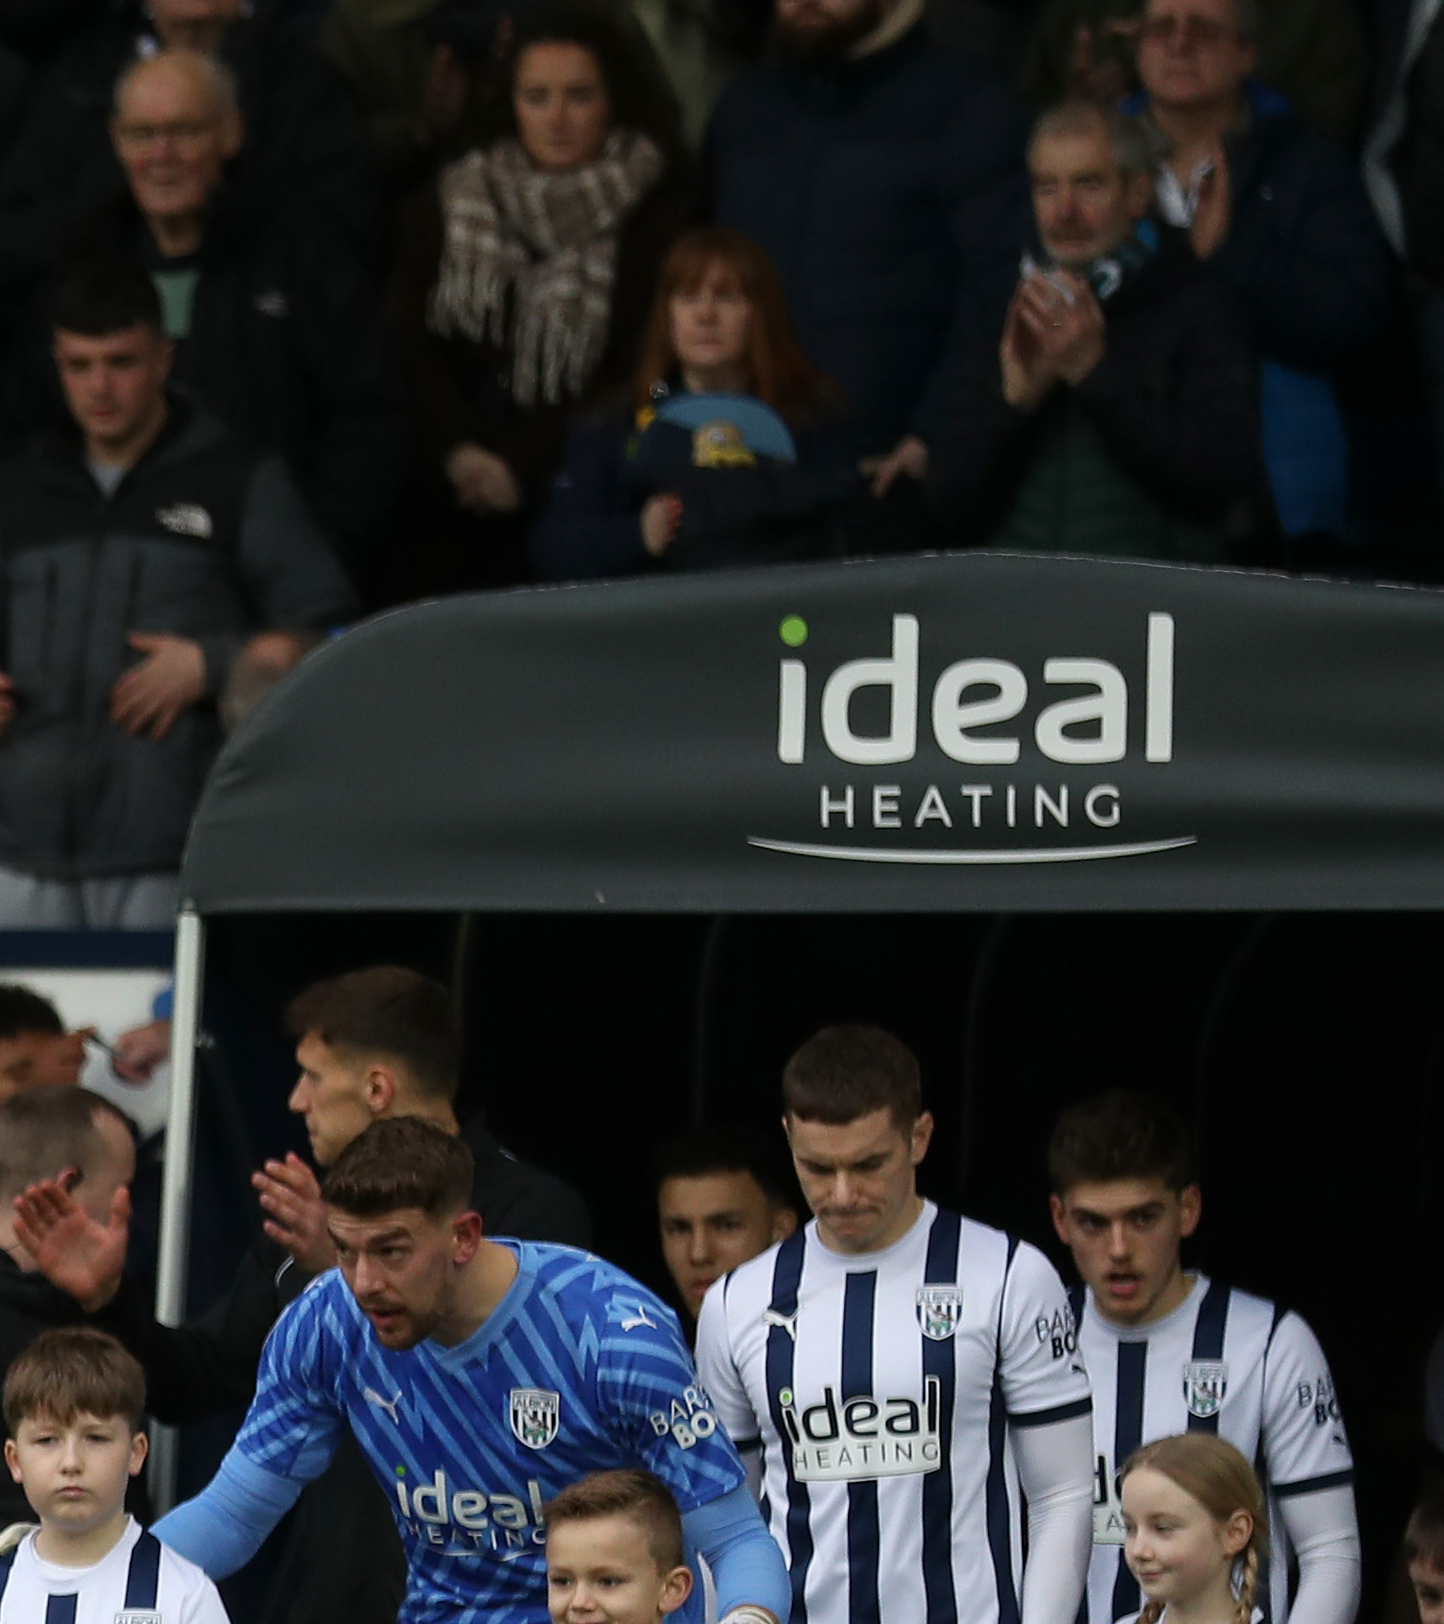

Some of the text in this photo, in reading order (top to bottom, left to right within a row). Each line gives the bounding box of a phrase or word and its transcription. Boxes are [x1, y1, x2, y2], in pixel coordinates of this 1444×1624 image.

[778, 611, 1175, 765] ideal
[819, 783, 1122, 829] HEATING
[780, 1379, 939, 1445] ideal
[794, 1442, 939, 1471] HEATING
[394, 1467, 545, 1530] ideal
